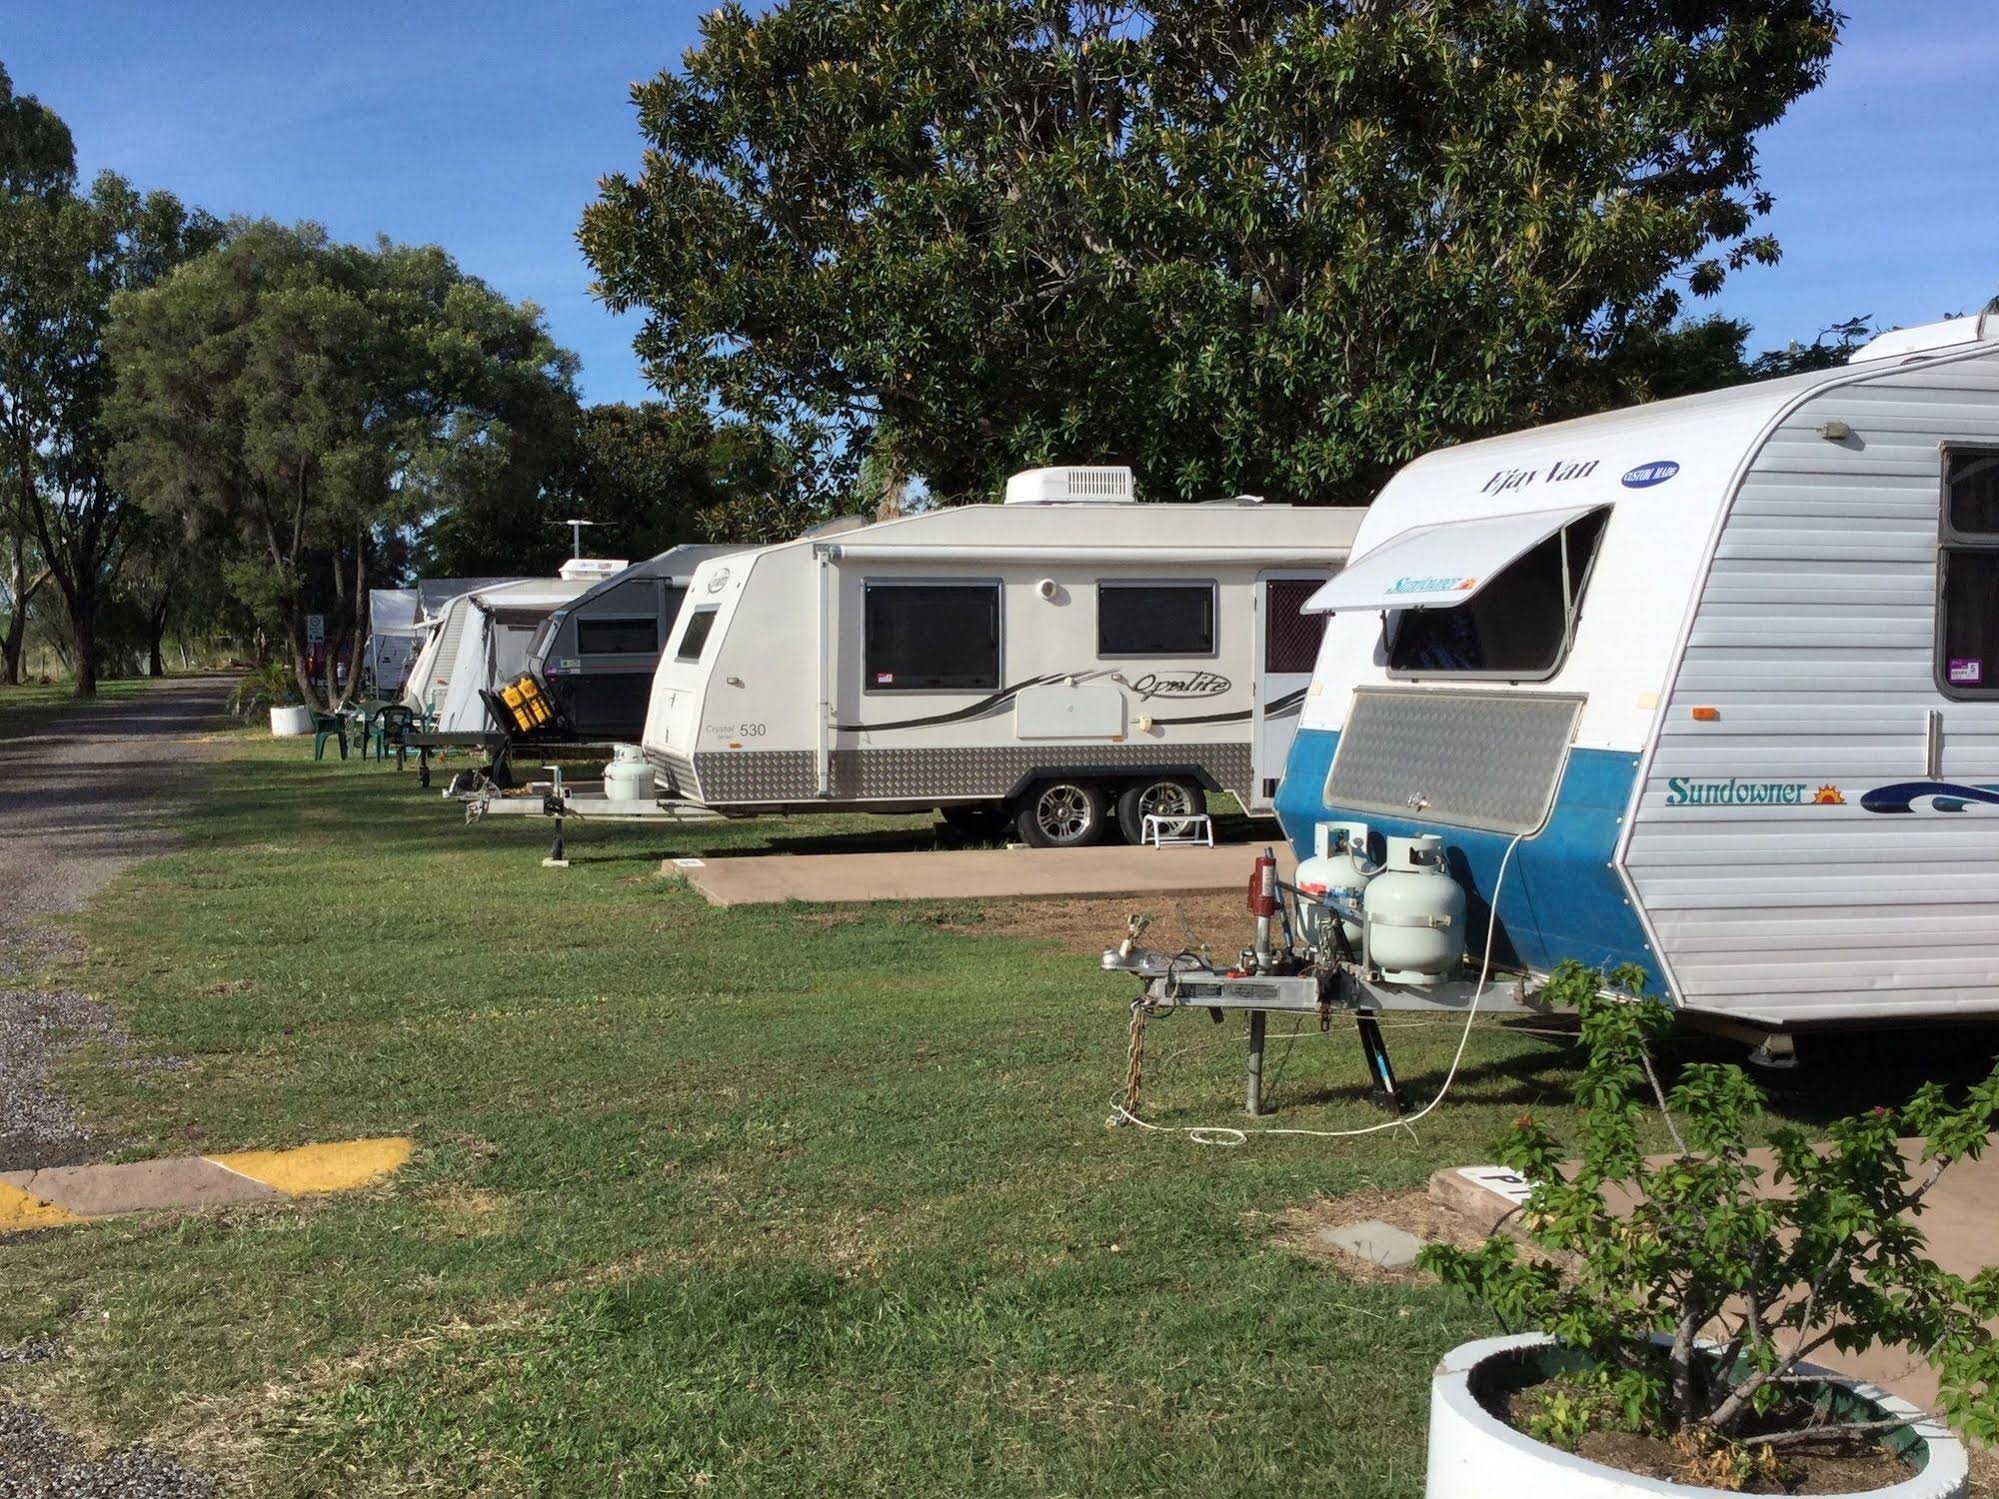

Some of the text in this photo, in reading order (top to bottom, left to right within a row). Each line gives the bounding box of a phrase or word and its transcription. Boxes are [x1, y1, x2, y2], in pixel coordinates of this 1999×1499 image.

[1545, 459, 1601, 484] Van
[740, 723, 767, 737] 530
[1666, 777, 1807, 804] Sundowner
